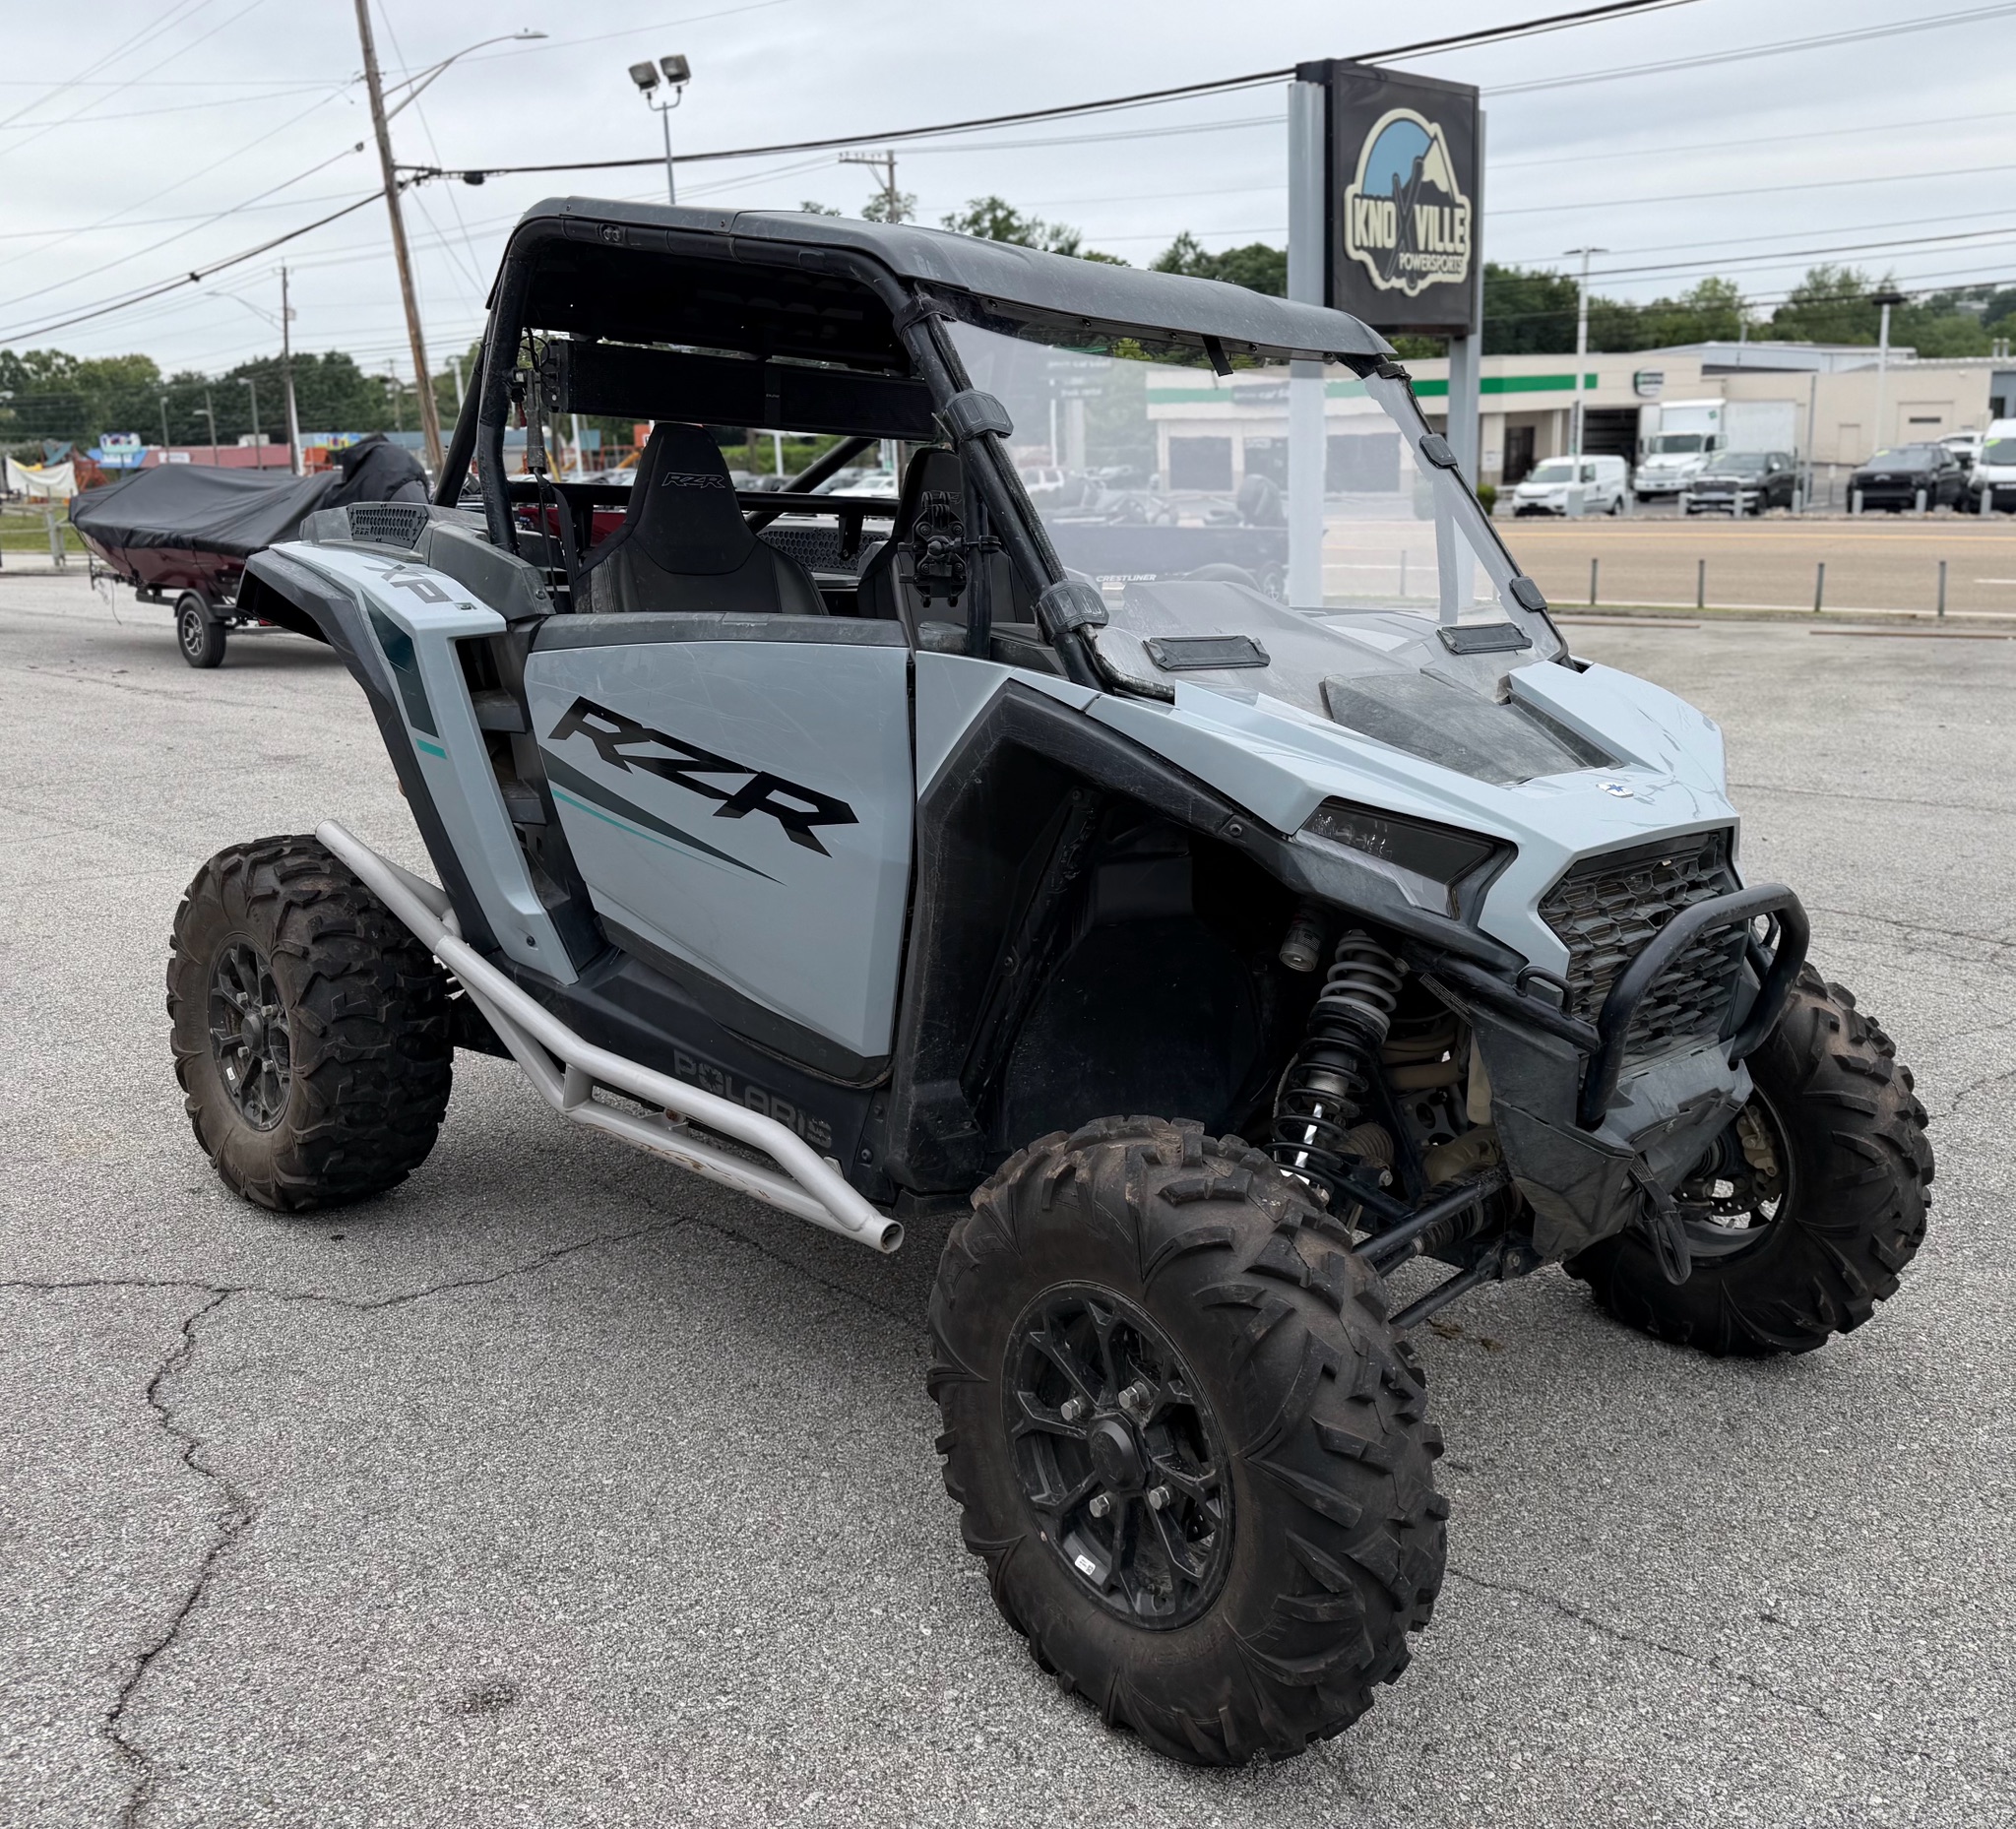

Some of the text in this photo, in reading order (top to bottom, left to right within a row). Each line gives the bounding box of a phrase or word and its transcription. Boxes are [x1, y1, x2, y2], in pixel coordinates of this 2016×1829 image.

[1354, 197, 1466, 254] KNOXVILLE
[1399, 252, 1464, 275] POWERSPORTS
[661, 472, 726, 489] RZR
[362, 563, 455, 604] XP
[1096, 574, 1157, 583] CRESTLINER
[546, 695, 861, 859] RZR
[673, 1047, 834, 1150] POLARIS
